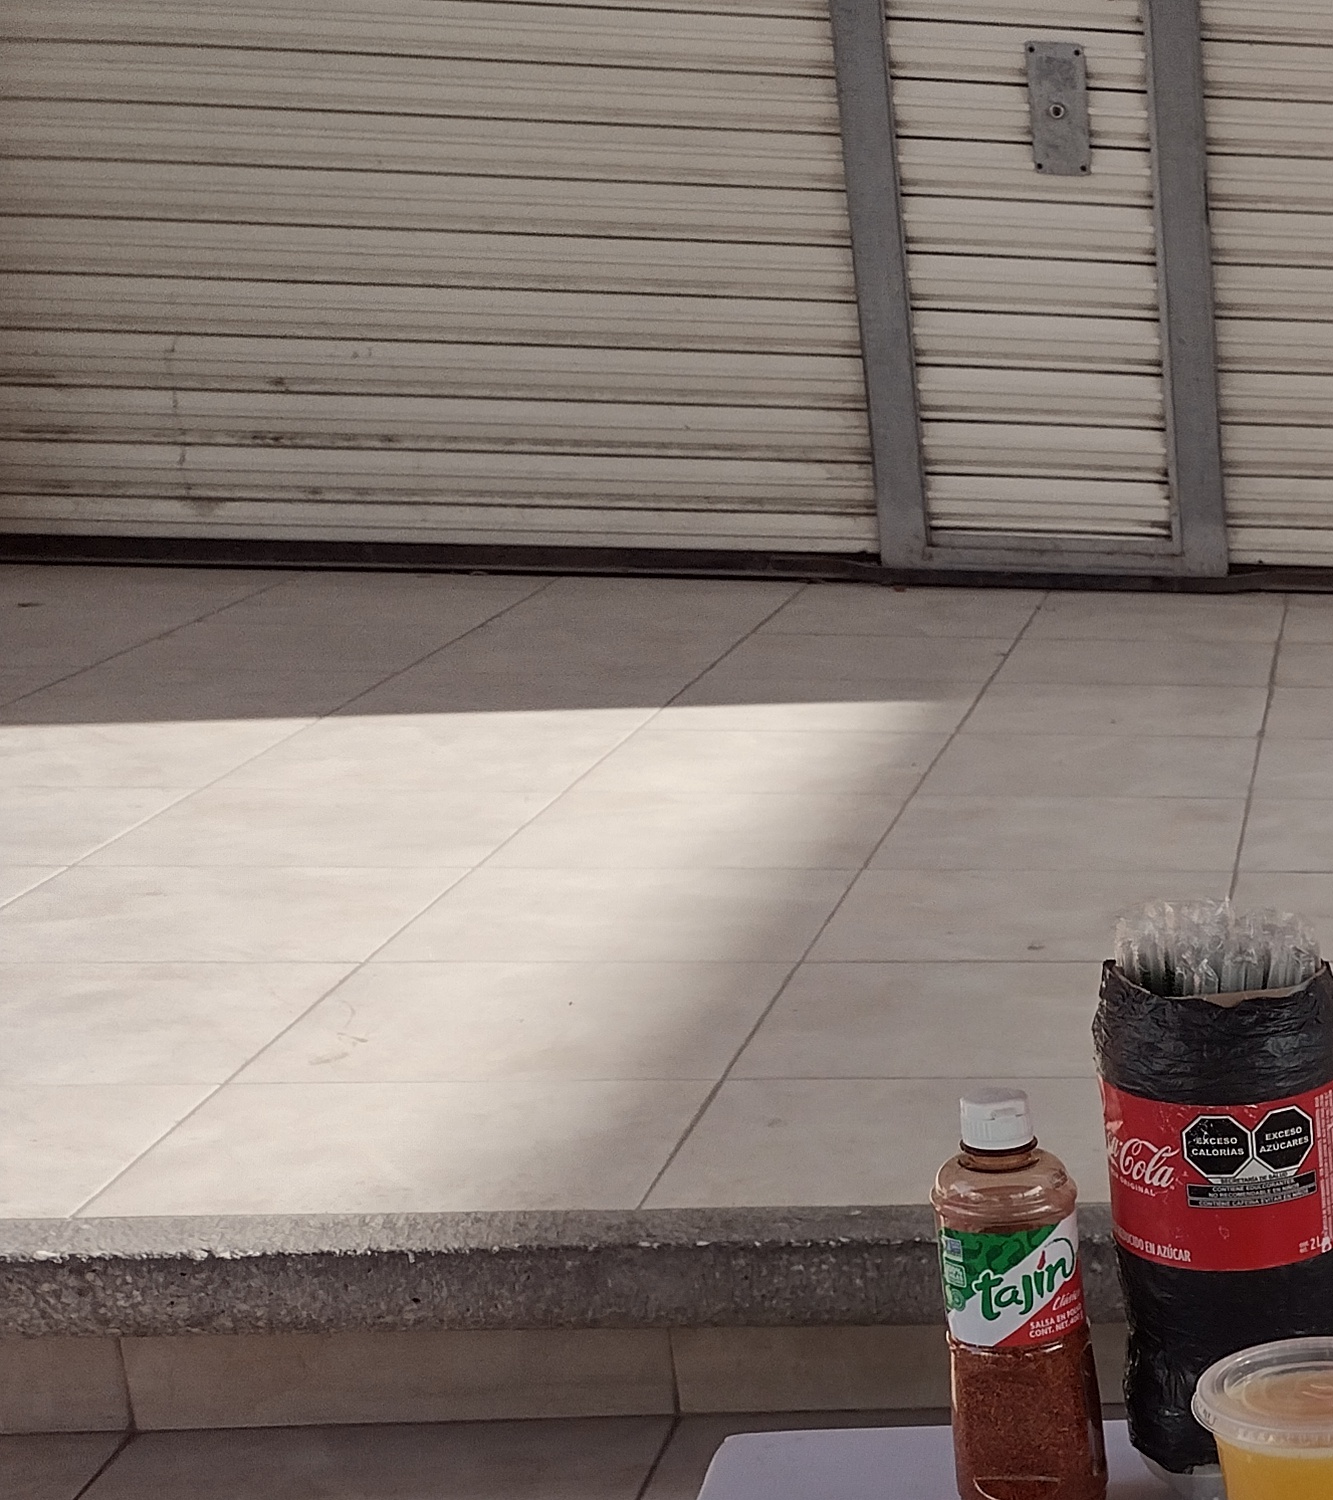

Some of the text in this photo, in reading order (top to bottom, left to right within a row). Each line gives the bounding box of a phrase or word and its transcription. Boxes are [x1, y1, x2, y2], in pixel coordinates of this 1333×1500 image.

[1195, 1136, 1238, 1146] EXCESO
[1265, 1126, 1303, 1142] EXCESO
[1191, 1146, 1245, 1157] CALORÍAS
[1259, 1135, 1310, 1154] AZÚCARES
[1156, 1243, 1192, 1263] AZÚCAR
[1030, 1317, 1056, 1330] SALSA
[1056, 1312, 1067, 1323] EN
